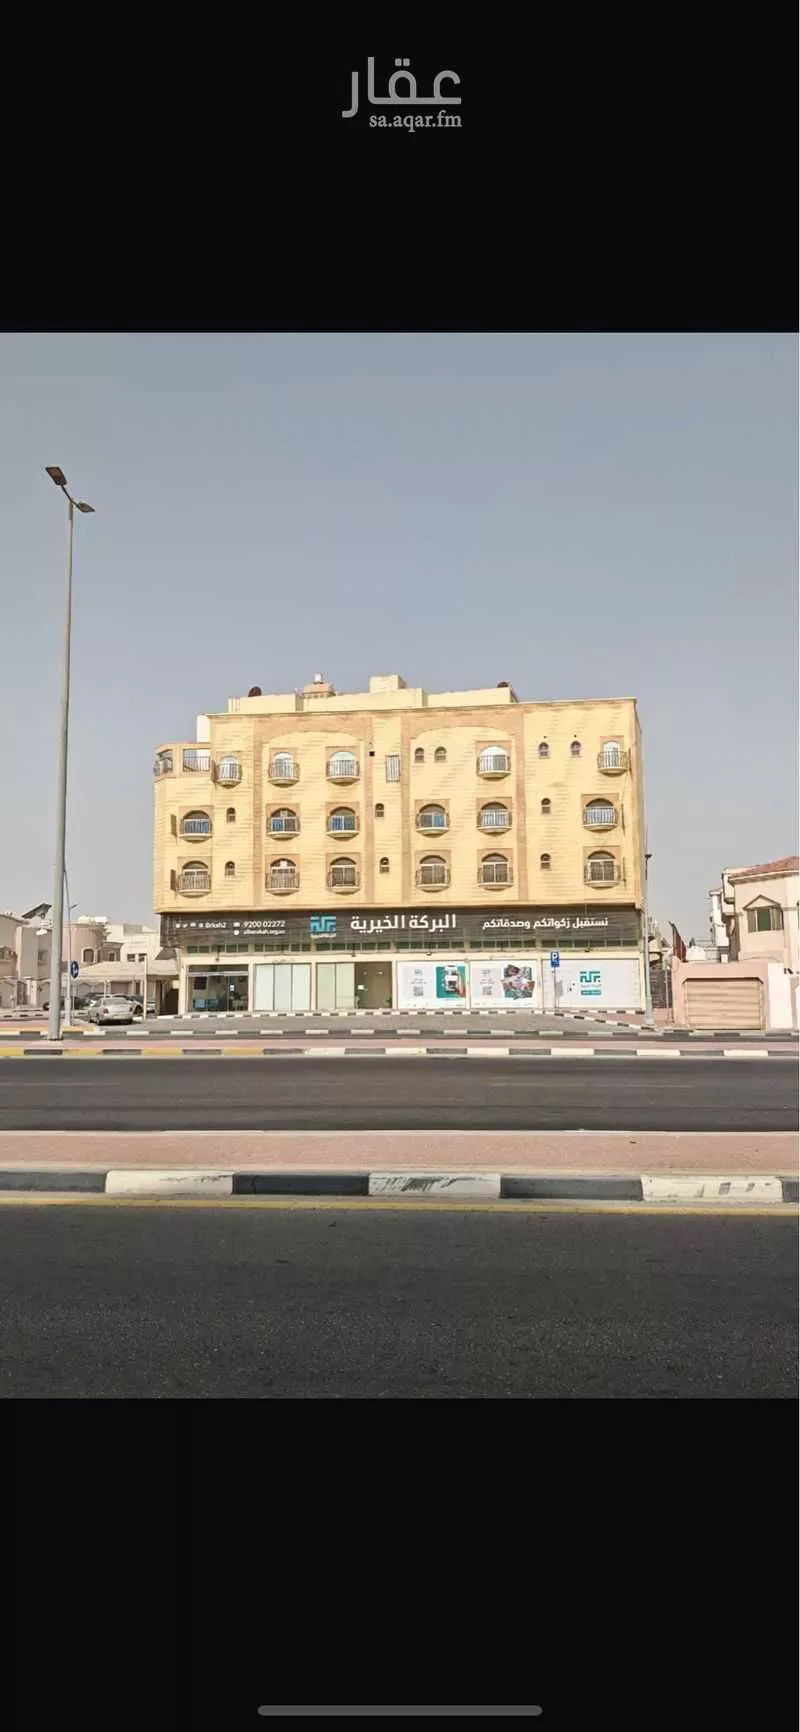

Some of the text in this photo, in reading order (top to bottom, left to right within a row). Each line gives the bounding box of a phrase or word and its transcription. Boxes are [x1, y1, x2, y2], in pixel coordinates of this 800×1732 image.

[350, 914, 456, 933] البركة الخيرية
[482, 917, 608, 930] نستقبل زكواتكم وصدقاتكم
